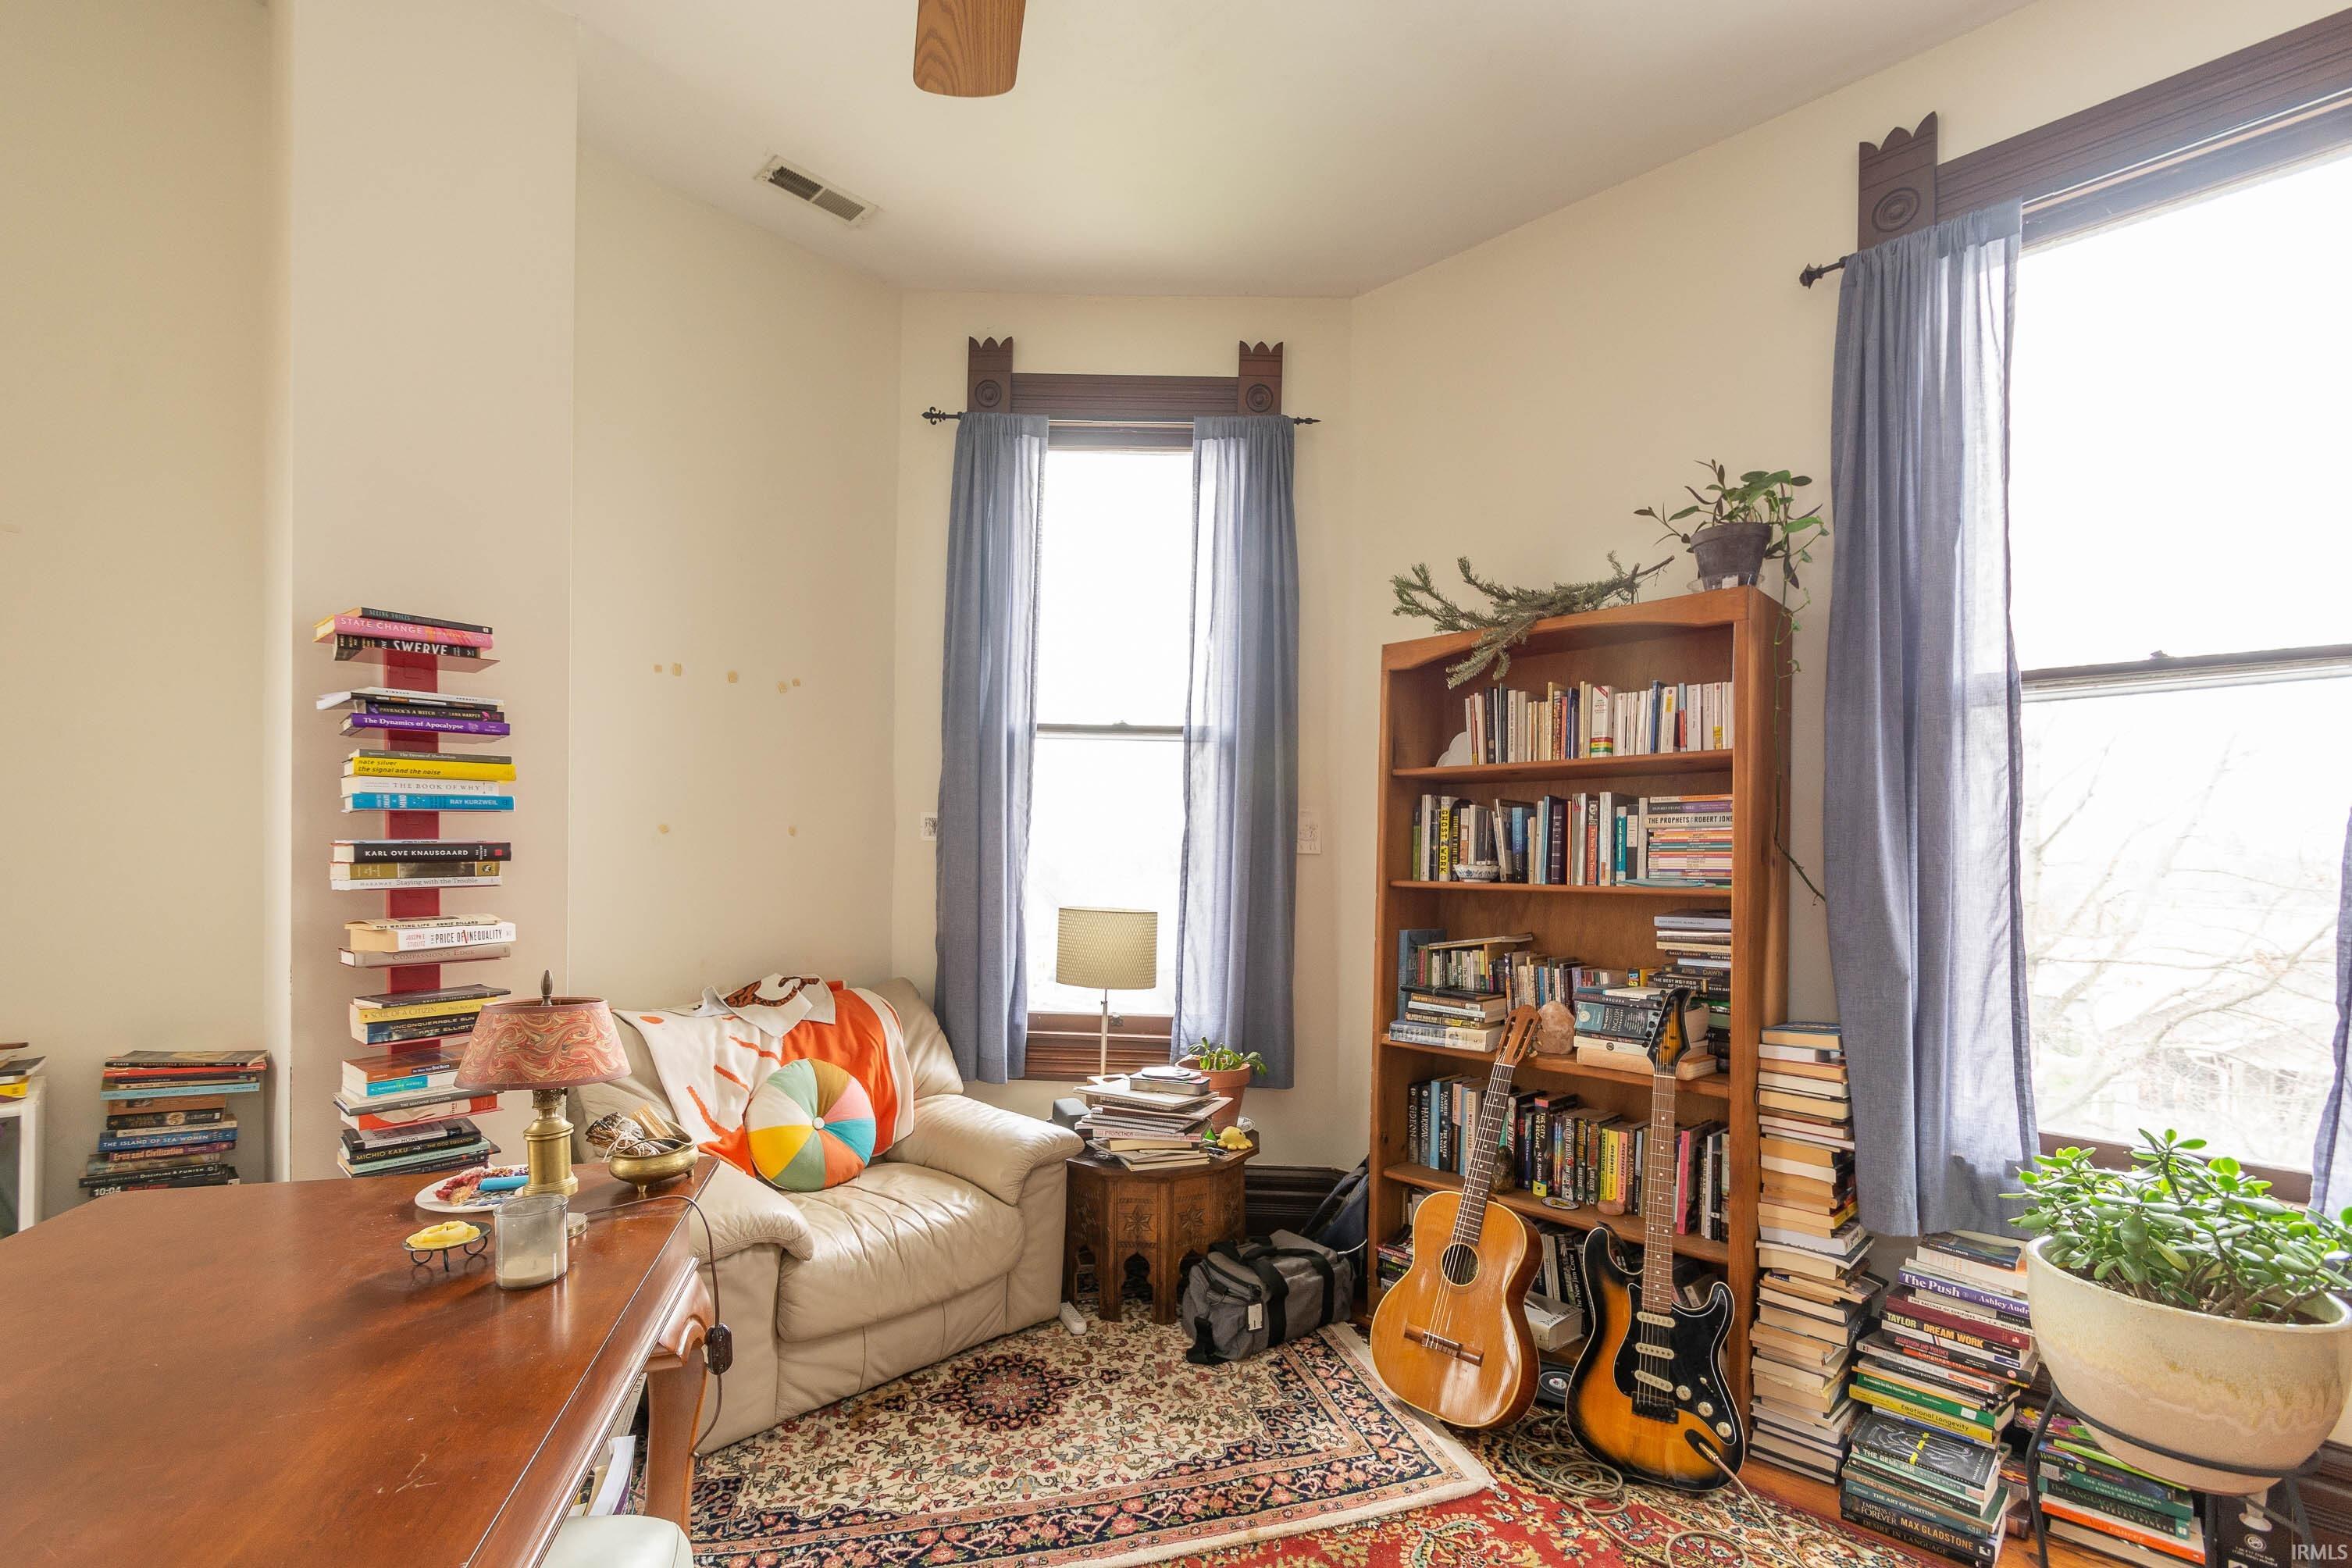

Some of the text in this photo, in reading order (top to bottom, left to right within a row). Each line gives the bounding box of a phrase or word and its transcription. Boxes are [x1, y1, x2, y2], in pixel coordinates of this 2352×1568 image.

[341, 618, 372, 628] STATE
[376, 622, 422, 634] CHANGE
[393, 640, 448, 655] SWERVE
[380, 718, 415, 728] Dynamics
[425, 722, 464, 731] Apocalypse
[435, 932, 454, 944] PRICE
[457, 932, 465, 941] OF
[392, 950, 451, 960] COMPASSION'S
[390, 1018, 458, 1029] UNCONQUERABLE
[1612, 1008, 1620, 1031] ENGLISH
[1535, 1115, 1540, 1124] WE
[450, 1137, 475, 1146] EQUATION
[114, 1153, 130, 1161] Eros
[145, 1147, 184, 1158] Civilization
[356, 1151, 386, 1161] MICHIO
[94, 1186, 122, 1196] 10:04
[1902, 1273, 2029, 1314] The Push Ashley Audr
[1887, 1313, 1916, 1327] TAYLOR
[1921, 1300, 1942, 1311] BACCHAE
[1951, 1309, 1976, 1320] EURIPIDES
[2000, 1323, 2024, 1333] WILLIAMS
[1923, 1323, 1983, 1349] DREAM WORK
[1901, 1404, 1969, 1431] Emotional Longevity
[1863, 1449, 1877, 1458] THE
[1880, 1454, 1899, 1468] BELL
[1901, 1463, 1915, 1474] JAR
[1944, 1479, 1961, 1490] PLATH
[1862, 1501, 1887, 1515] EMPRESS
[1908, 1505, 1937, 1518] WRITING
[1861, 1506, 1897, 1526] FOREVER
[2139, 1517, 2175, 1533] PINKER
[1901, 1518, 1974, 1551] MAX GLADSTONE
[1892, 1530, 1901, 1538] IN
[1904, 1534, 1948, 1555] LANGUAGE
